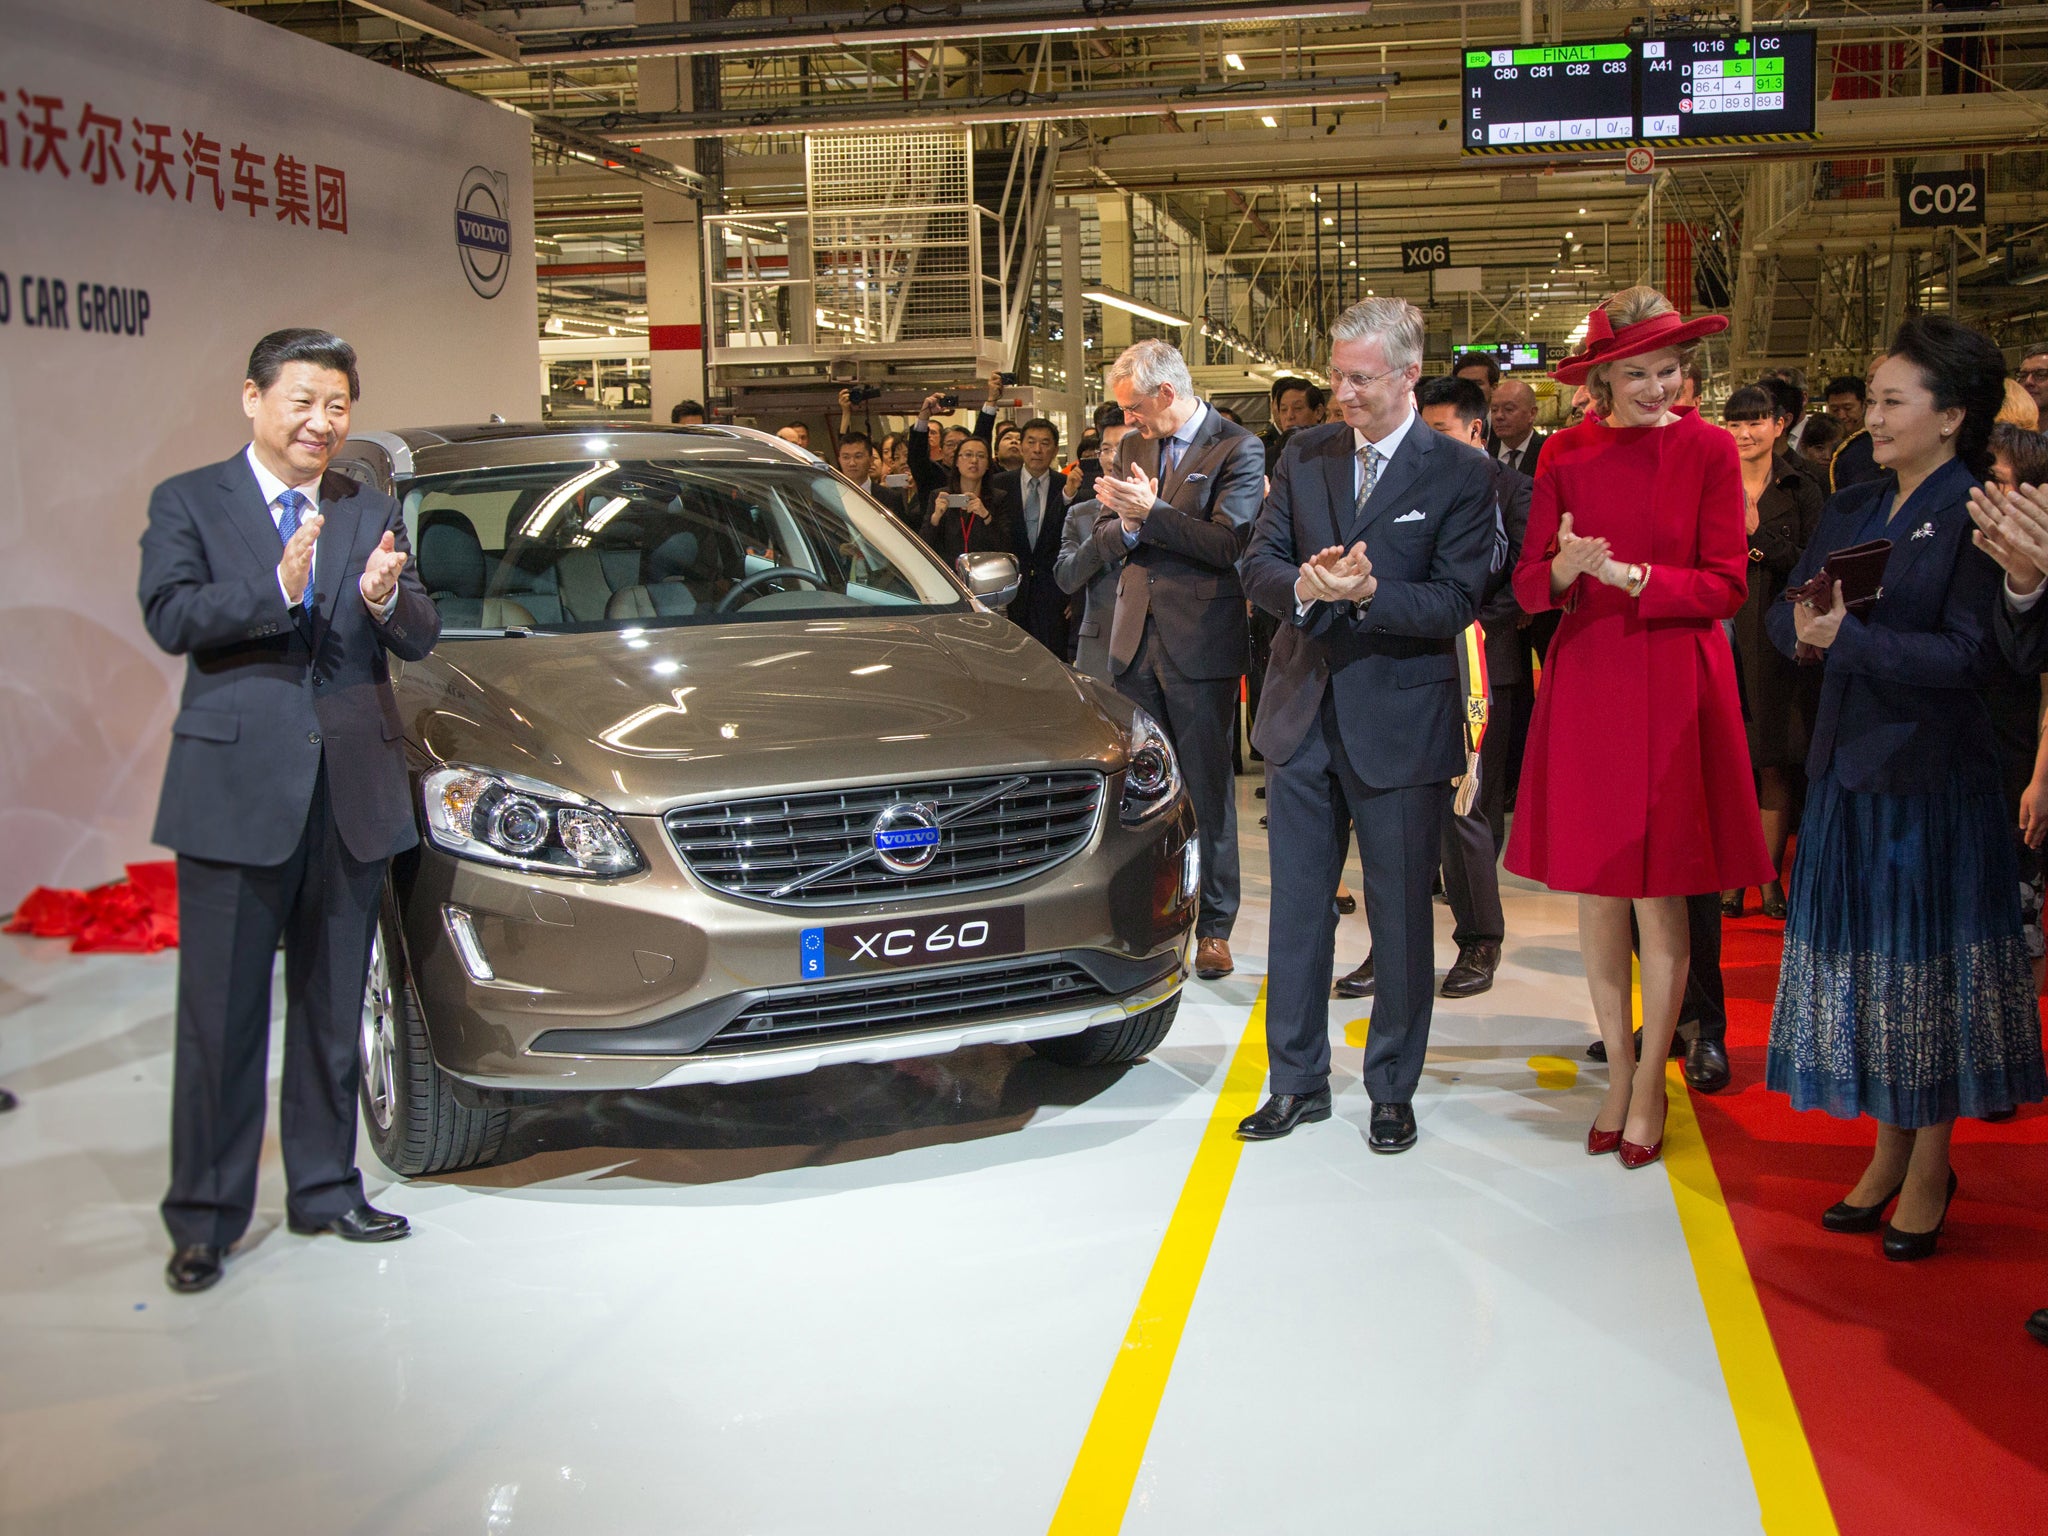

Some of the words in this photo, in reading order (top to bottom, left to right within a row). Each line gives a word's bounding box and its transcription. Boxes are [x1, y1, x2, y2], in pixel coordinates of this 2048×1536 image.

[1650, 44, 1658, 55] 0
[1692, 40, 1725, 53] 10:16
[1760, 38, 1780, 50] GC
[1498, 53, 1506, 63] 6
[1494, 68, 1518, 80] C80
[1530, 66, 1553, 78] C81
[1566, 64, 1590, 76] C82
[1602, 62, 1627, 74] C83
[1650, 60, 1673, 72] A41
[1681, 65, 1691, 76] D
[1697, 64, 1719, 75] 264
[1735, 63, 1742, 73] 5
[1766, 61, 1773, 71] 4
[1471, 87, 1481, 99] H
[1681, 83, 1692, 94] Q
[1695, 81, 1720, 92] 86.4
[1734, 80, 1741, 90] 4
[1757, 78, 1782, 89] 91.3
[1699, 99, 1717, 110] 2.0
[1725, 97, 1750, 108] 89.8
[1757, 95, 1782, 107] 89.8
[1472, 108, 1481, 119] E
[1472, 128, 1482, 140] Q
[459, 219, 507, 245] VOLVO
[1407, 245, 1446, 266] X06
[21, 275, 70, 330] CAR
[77, 281, 151, 337] GROUP
[882, 831, 936, 845] VOLVO
[808, 959, 818, 971] S
